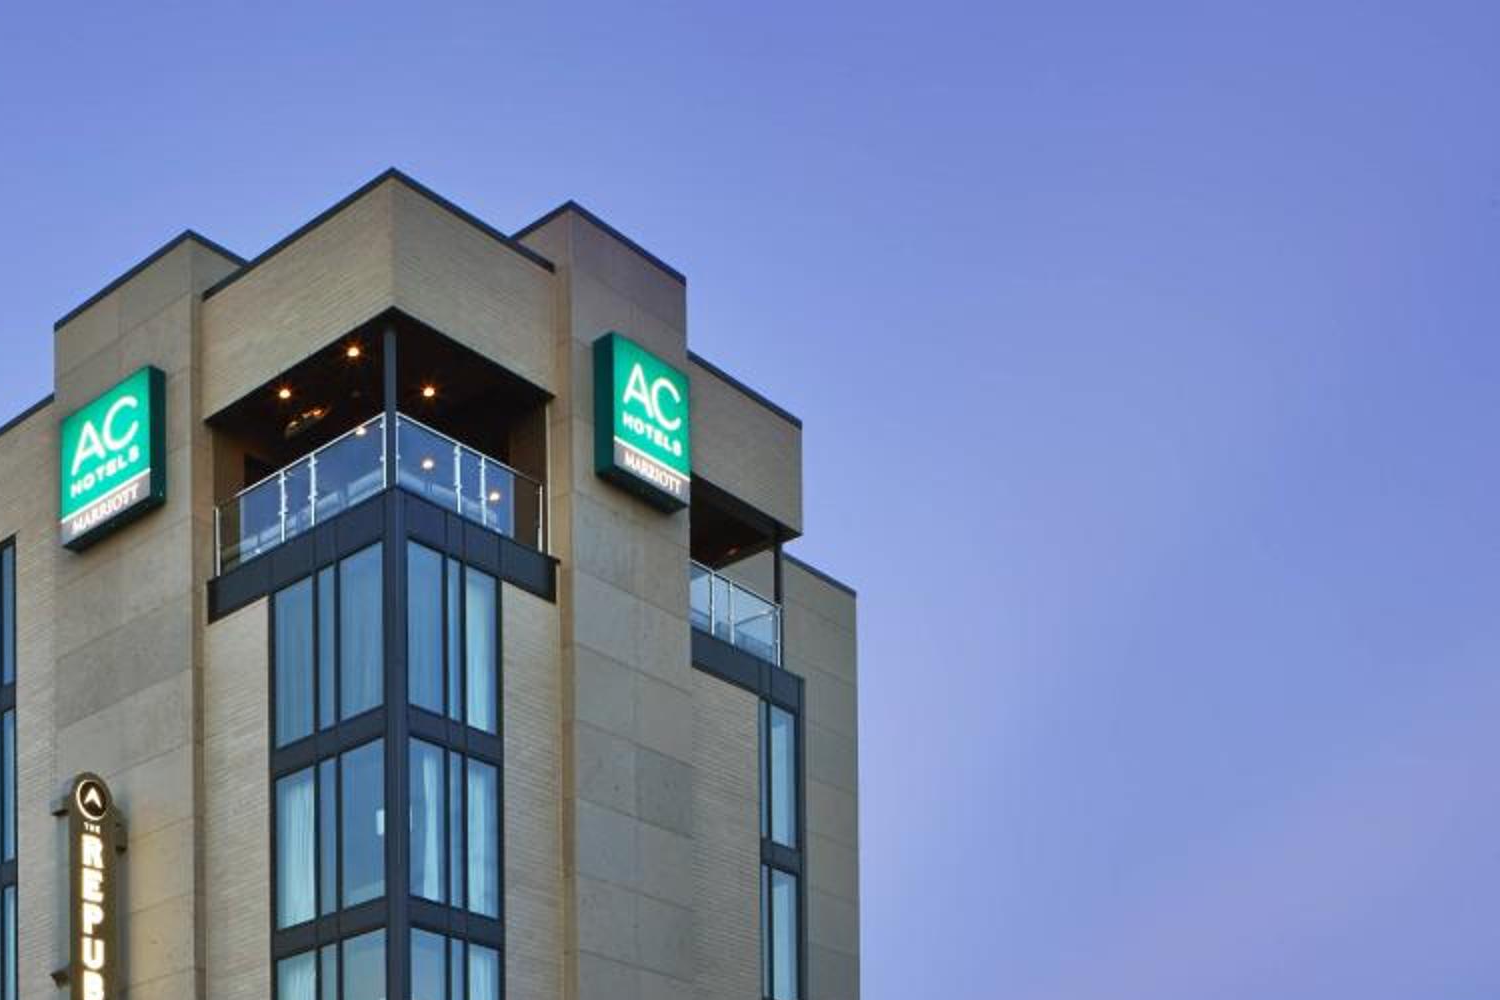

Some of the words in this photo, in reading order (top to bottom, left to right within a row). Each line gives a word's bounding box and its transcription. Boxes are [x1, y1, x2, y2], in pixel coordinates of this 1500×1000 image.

[623, 363, 682, 431] AC
[70, 395, 139, 477] AC
[622, 411, 683, 457] HOTELS
[70, 445, 141, 498] HOTELS
[624, 450, 682, 494] MARRIOTT
[71, 483, 140, 535] MARRIOTT
